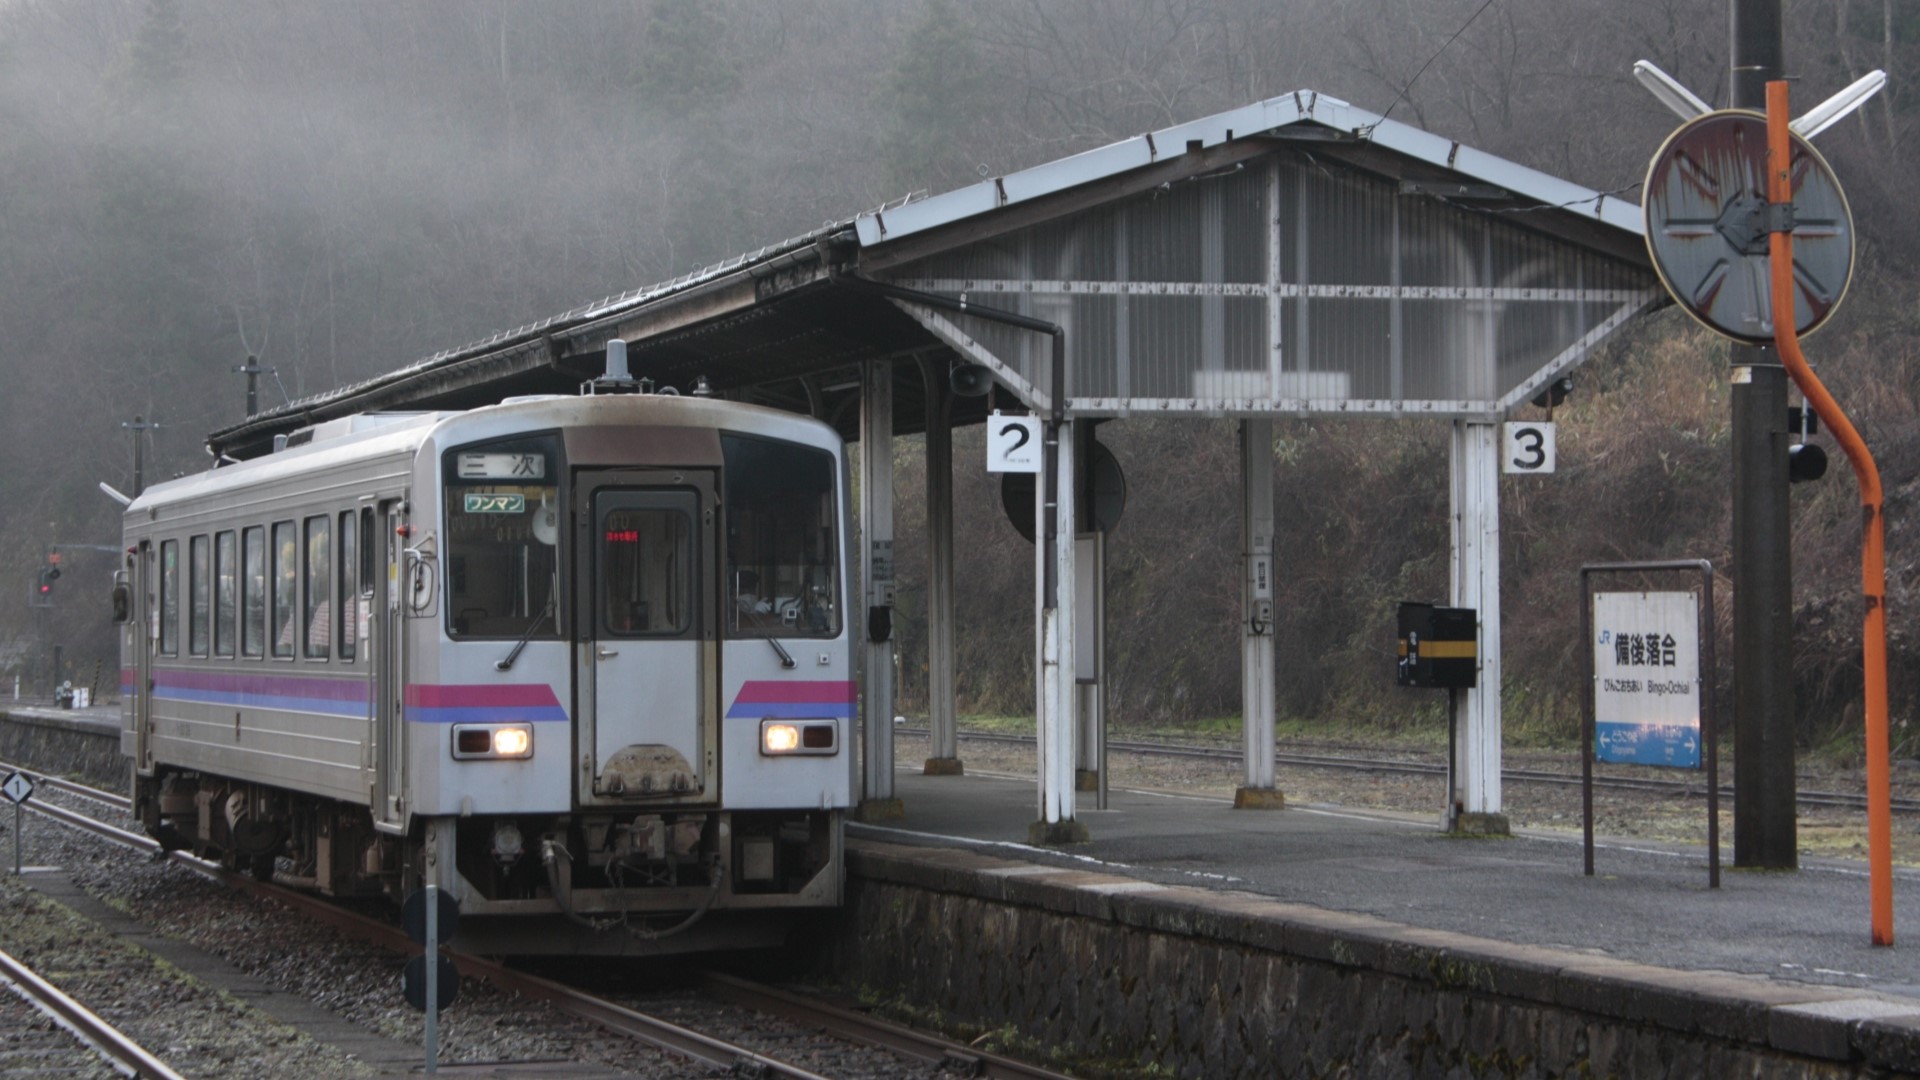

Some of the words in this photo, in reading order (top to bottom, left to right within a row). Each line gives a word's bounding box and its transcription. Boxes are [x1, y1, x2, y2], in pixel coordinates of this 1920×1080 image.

[1513, 428, 1546, 470] 3
[463, 454, 535, 476] 三次
[468, 496, 522, 511] ワンマン
[1599, 630, 1610, 645] JR
[1615, 632, 1676, 667] 備後落合
[15, 780, 20, 796] 1
